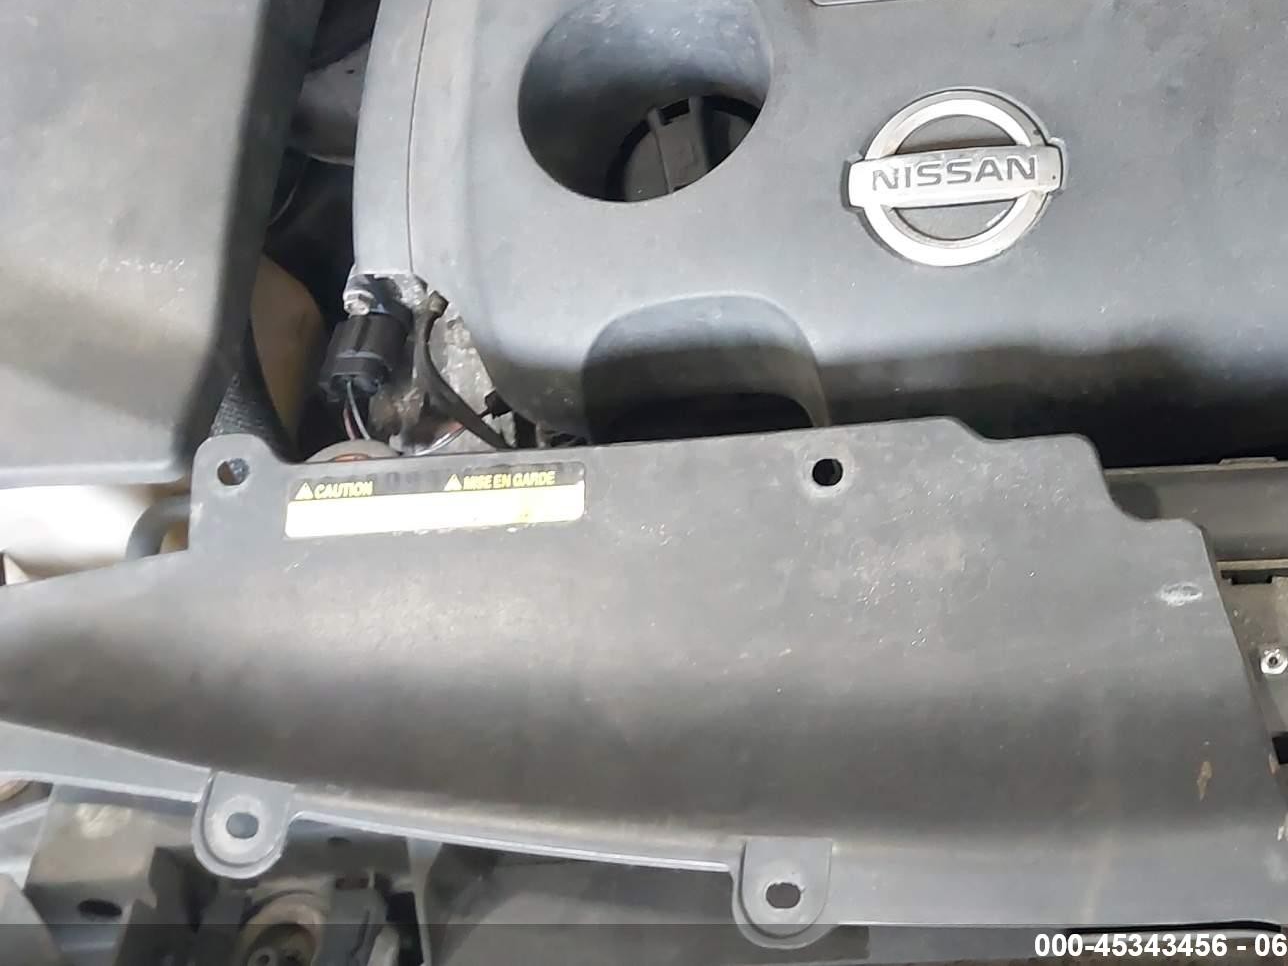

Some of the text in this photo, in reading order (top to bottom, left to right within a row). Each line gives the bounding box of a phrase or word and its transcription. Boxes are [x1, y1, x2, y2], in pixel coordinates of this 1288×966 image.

[872, 155, 1036, 191] NISSAN
[493, 474, 511, 489] EN
[513, 471, 555, 487] GARDE
[314, 481, 373, 500] CAUTION
